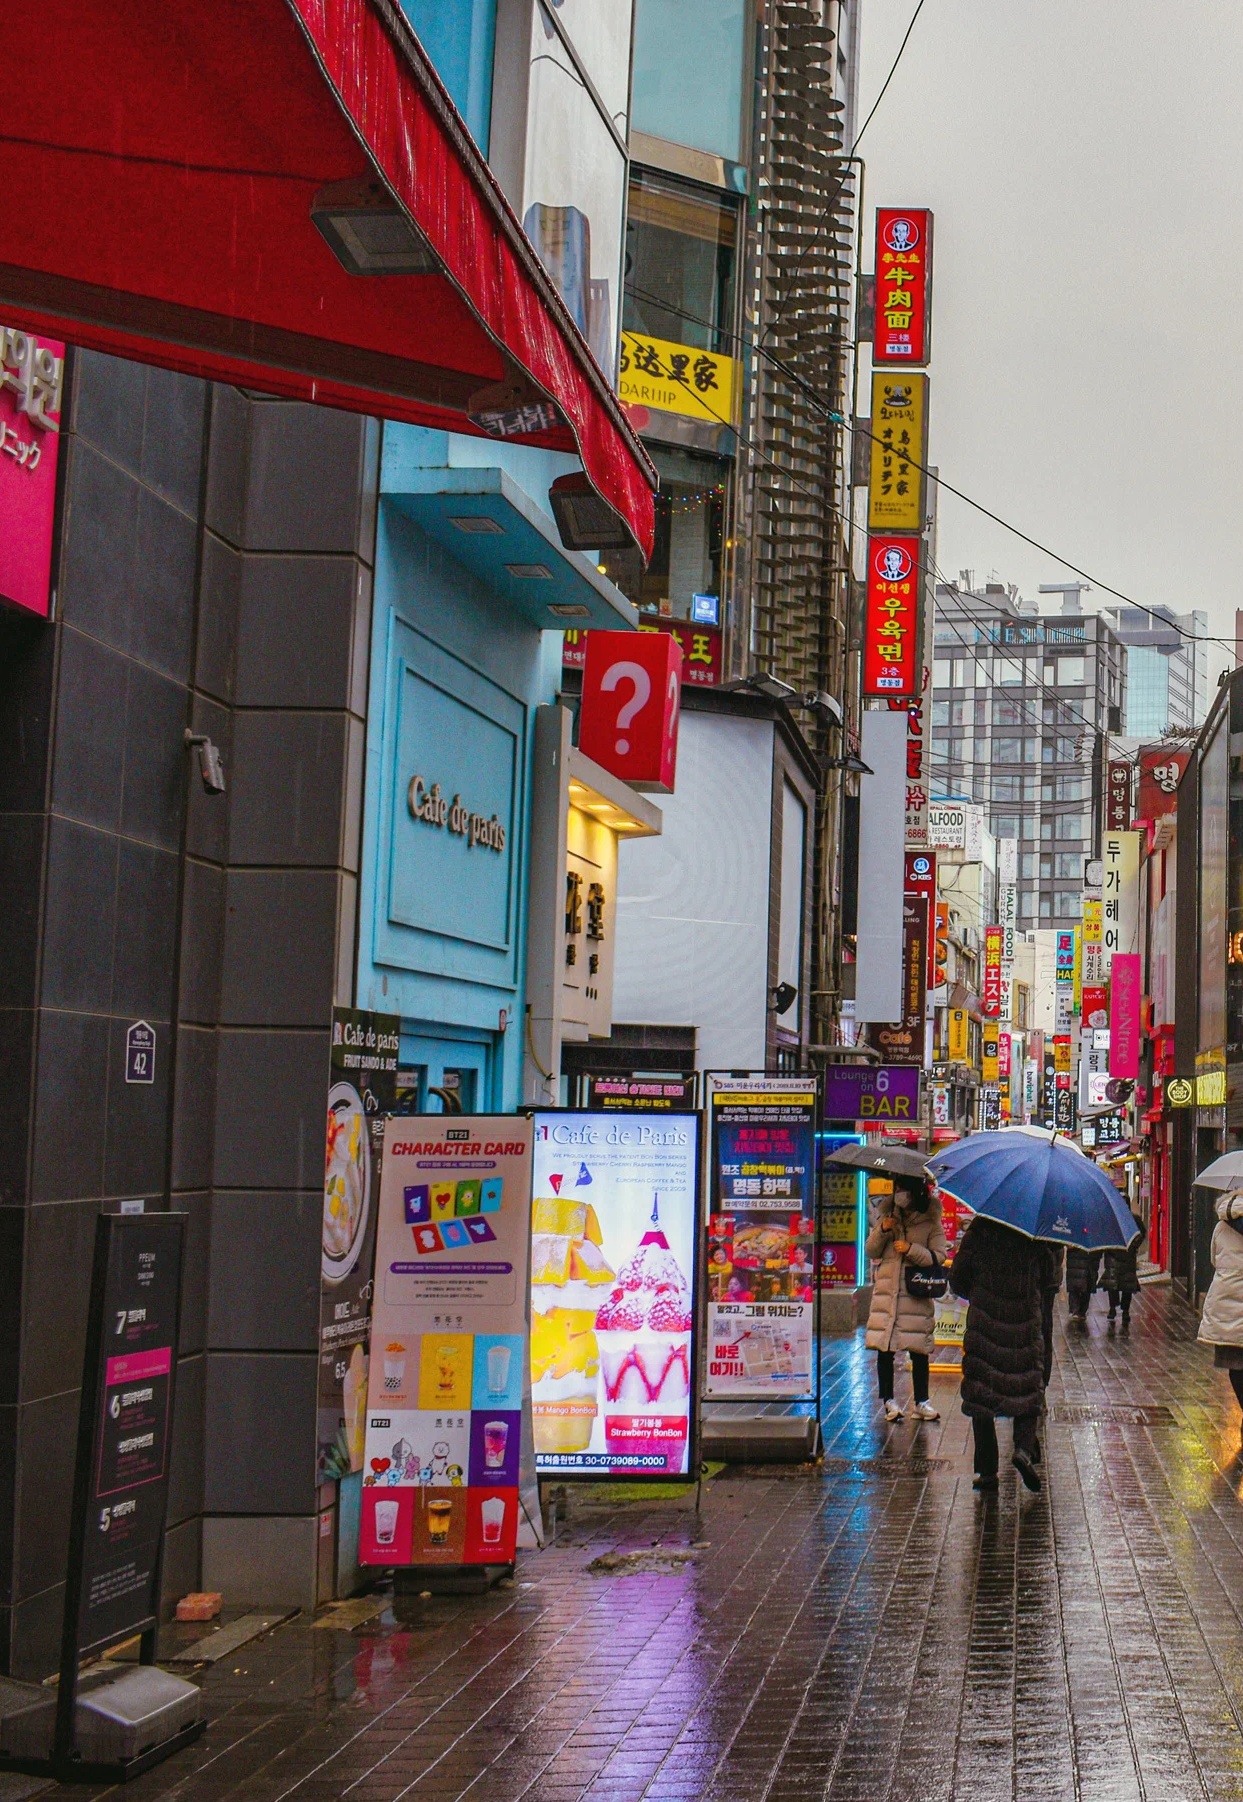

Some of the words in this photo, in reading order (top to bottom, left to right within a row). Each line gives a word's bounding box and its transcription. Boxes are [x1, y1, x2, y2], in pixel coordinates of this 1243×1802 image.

[884, 267, 914, 331] 牛肉面
[876, 598, 908, 662] 우육면
[408, 775, 449, 827] Cafe
[449, 794, 469, 834] de
[468, 812, 507, 850] paris
[1006, 889, 1014, 922] HALAL
[1105, 842, 1121, 951] 두가헤어
[907, 1016, 920, 1026] 3F
[344, 1022, 364, 1047] Cafe
[365, 1030, 376, 1048] de
[378, 1030, 399, 1053] paris
[133, 1053, 146, 1074] 42
[344, 1053, 360, 1068] FRUIT
[360, 1055, 380, 1069] SANDO
[385, 1058, 397, 1071] ADE
[834, 1070, 875, 1082] Lounge
[860, 1082, 874, 1091] on
[876, 1071, 889, 1092] 6
[859, 1095, 910, 1117] BAR
[552, 1124, 599, 1145] Cafe
[605, 1124, 632, 1146] de
[637, 1126, 688, 1146] Paris
[391, 1142, 481, 1155] CHARACTER
[484, 1142, 526, 1156] CARD
[715, 1345, 739, 1359] 바로
[545, 1405, 567, 1417] Mango
[568, 1405, 597, 1416] BonBon
[611, 1428, 651, 1439] Strawberry
[653, 1428, 683, 1438] BonBon
